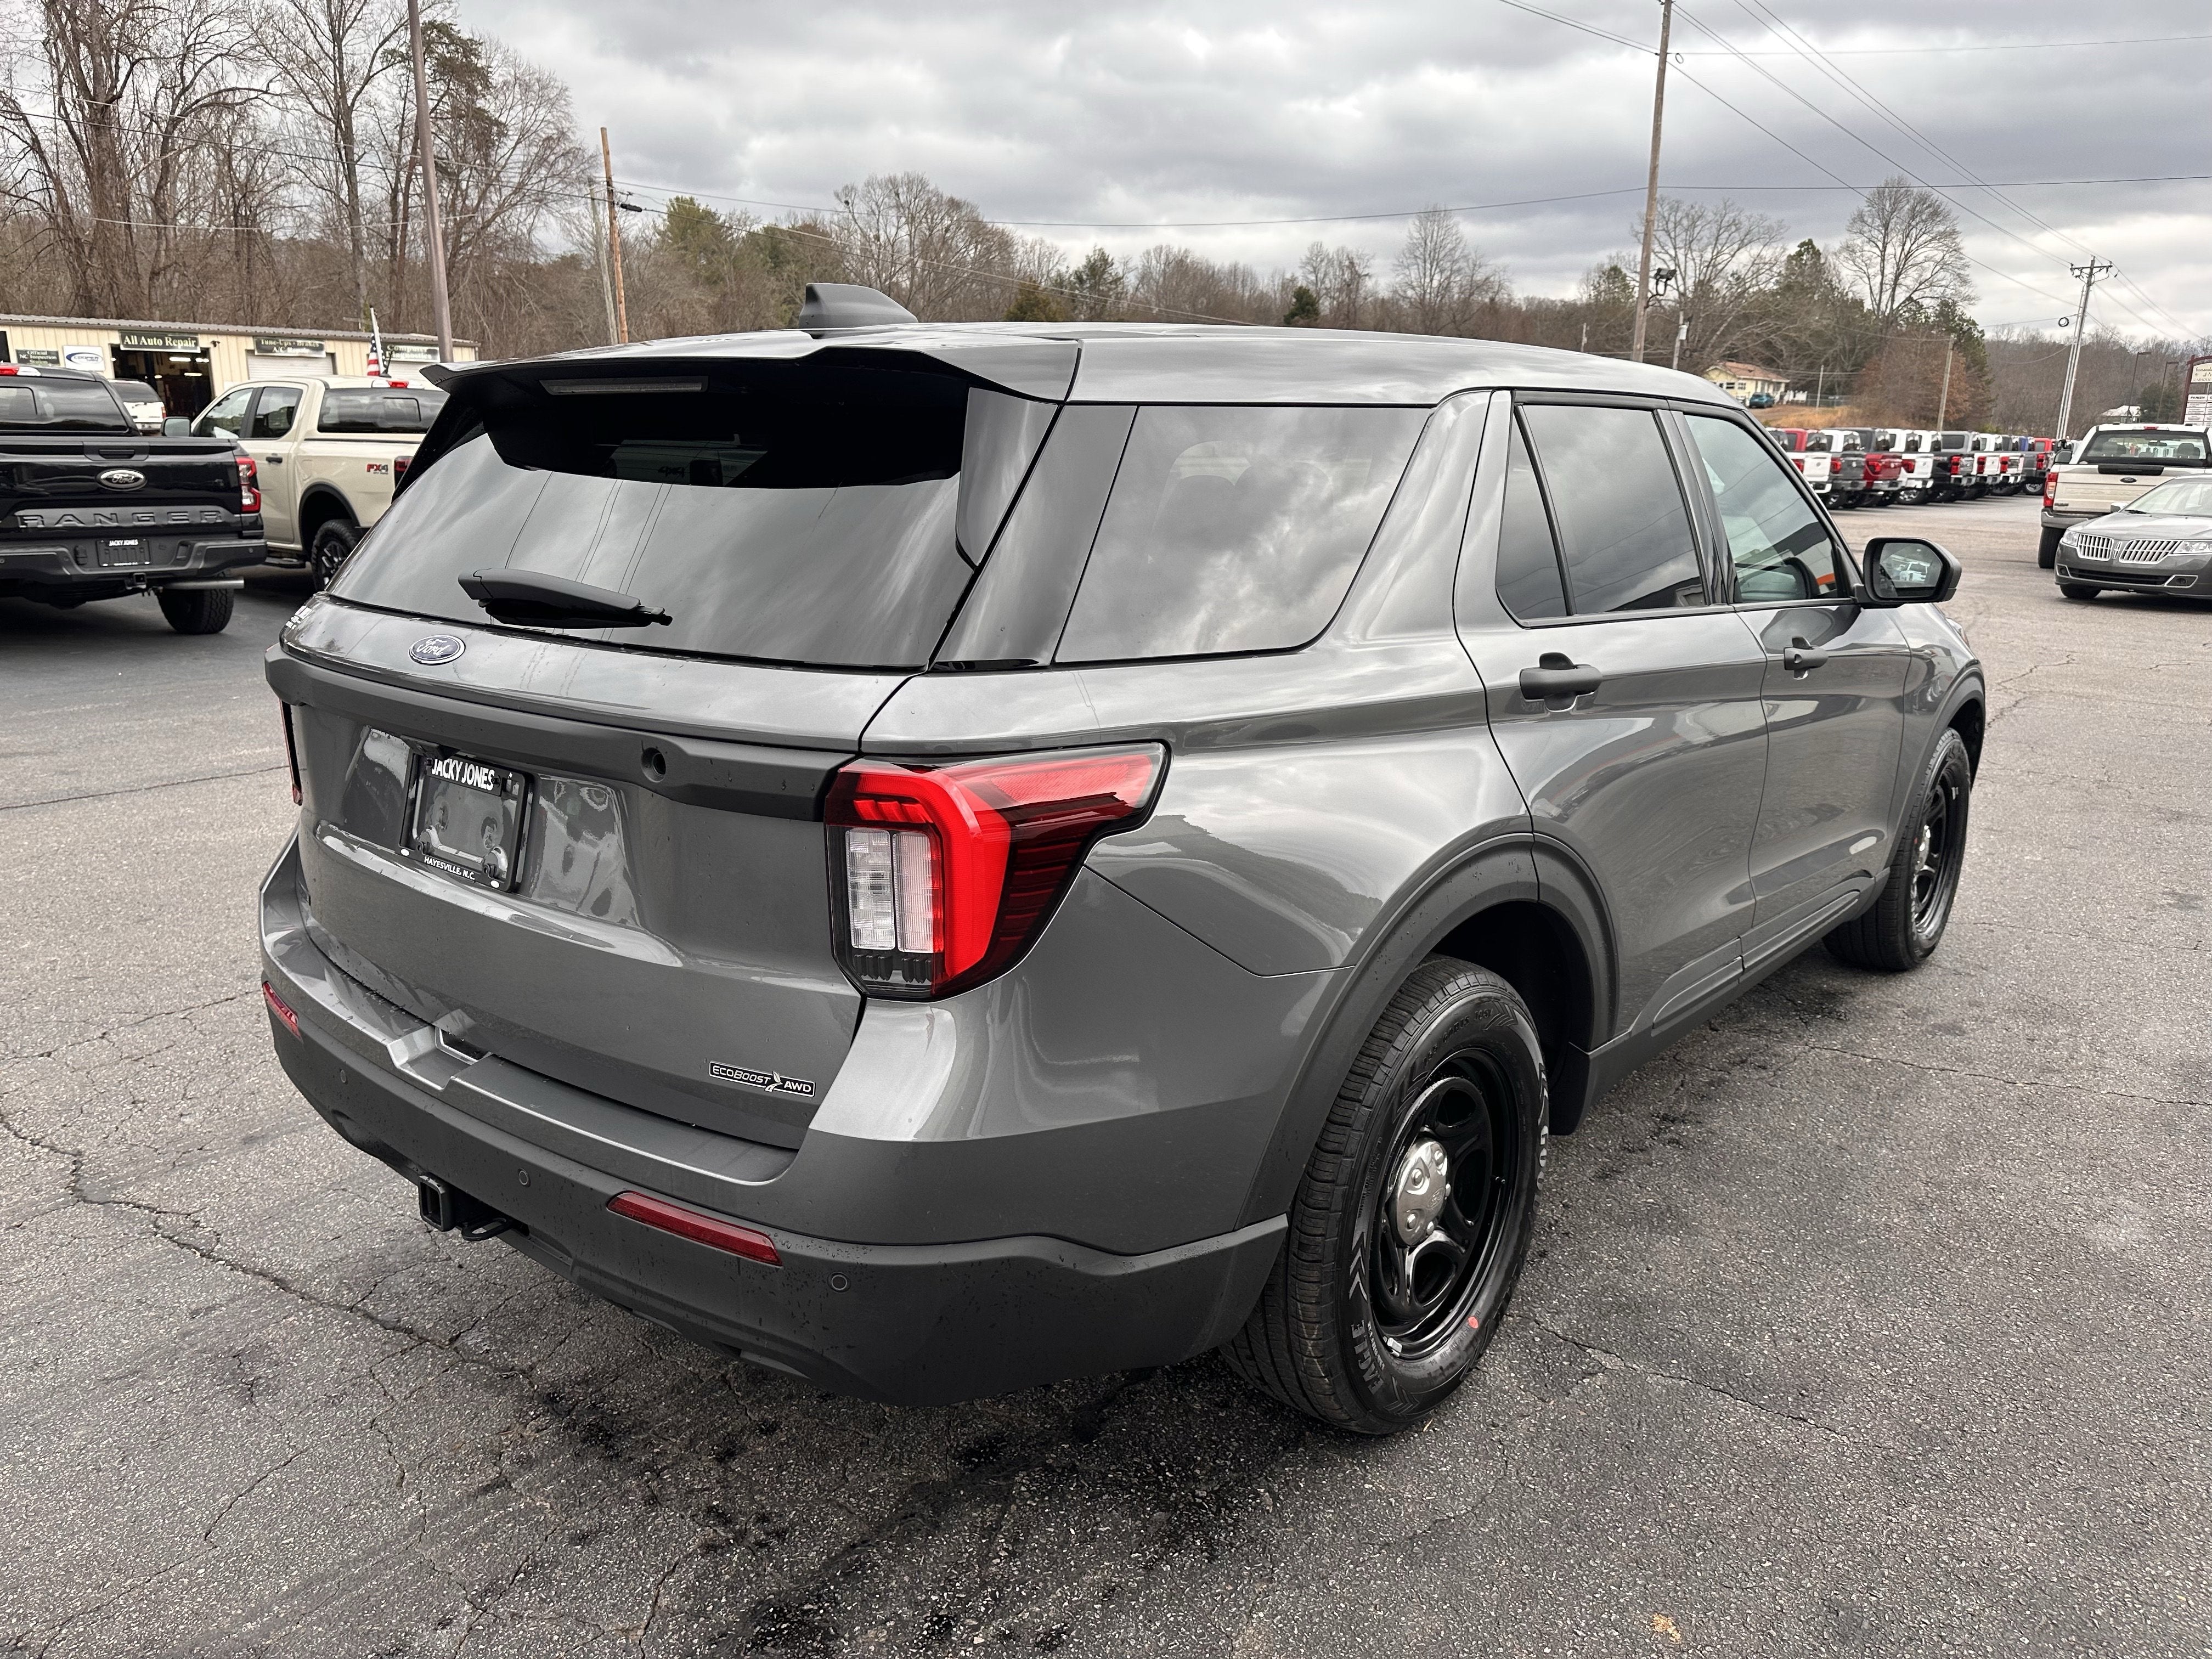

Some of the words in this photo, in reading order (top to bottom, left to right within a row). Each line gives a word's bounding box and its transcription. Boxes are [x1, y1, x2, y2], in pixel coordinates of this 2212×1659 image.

[123, 335, 138, 345] All
[139, 336, 163, 346] Auto
[165, 336, 196, 349] Repair
[366, 464, 388, 472] FX4
[17, 511, 222, 528] RANGER
[416, 638, 451, 657] Ford
[431, 758, 462, 781] JACKY
[461, 763, 495, 791] JONES
[783, 1080, 811, 1093] AWD
[1351, 1319, 1384, 1395] EAGLE
